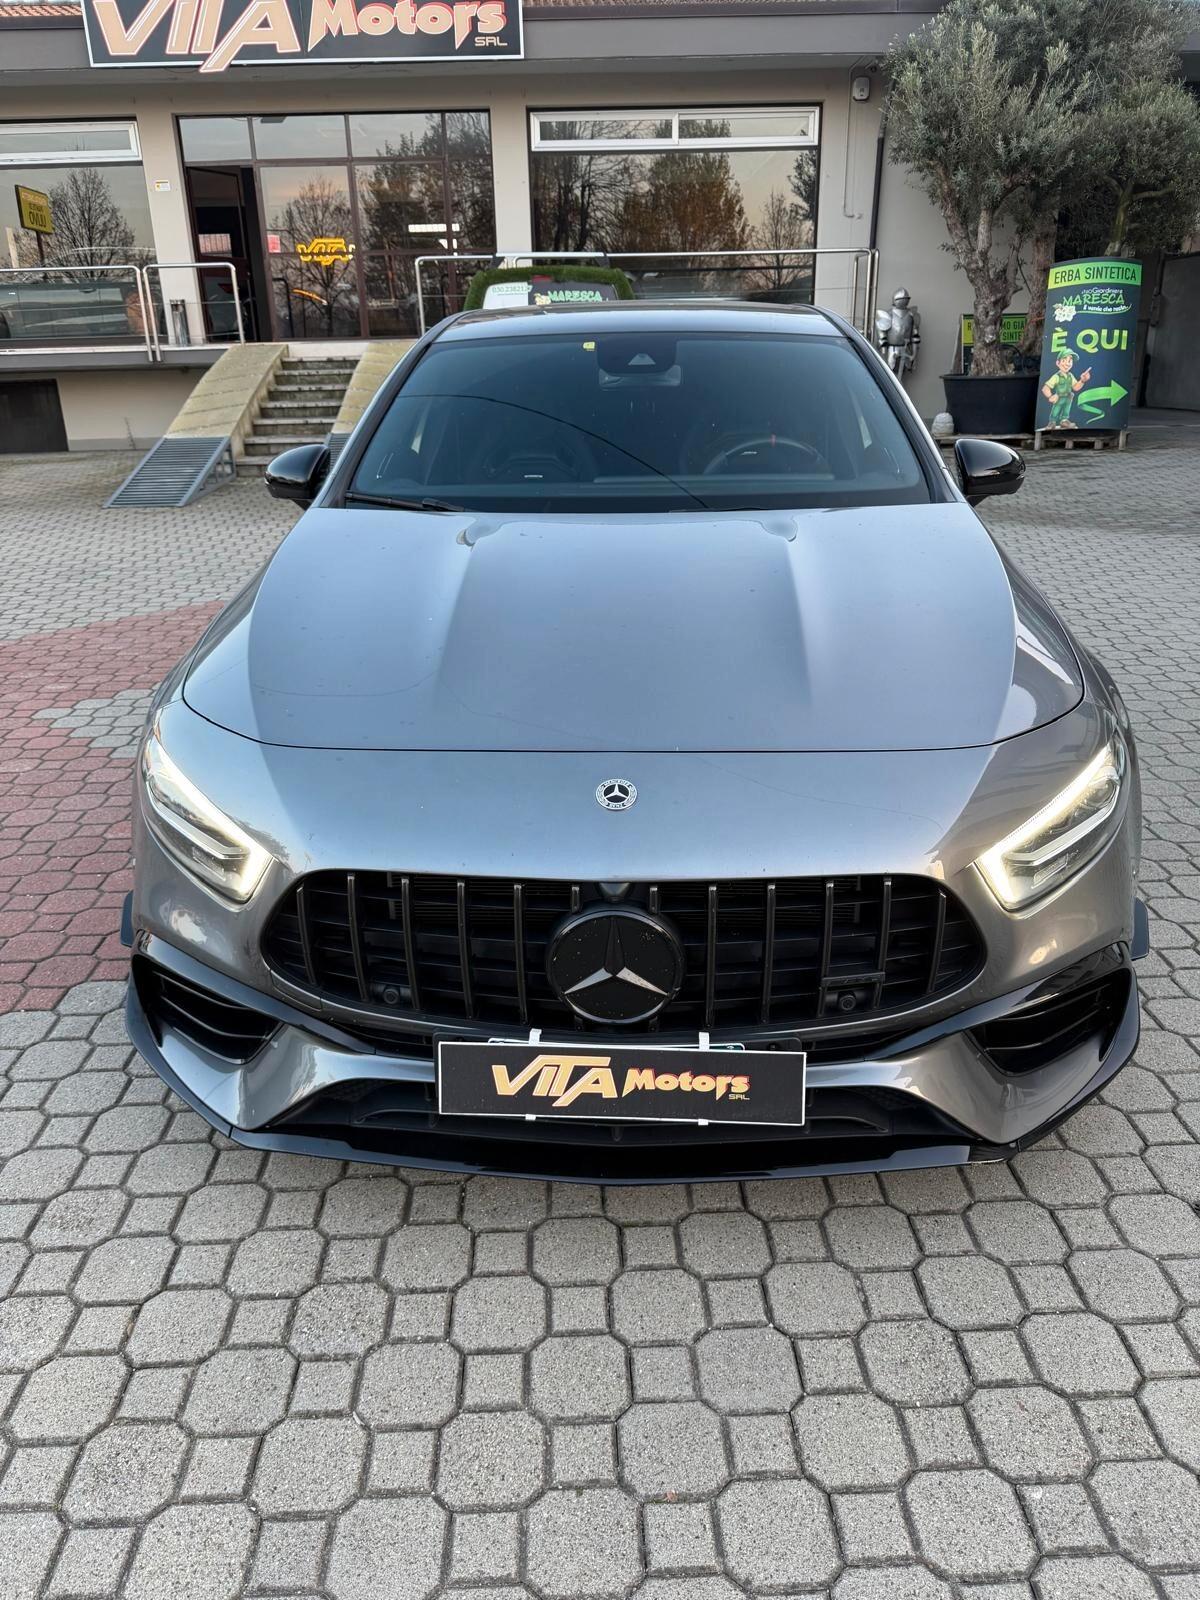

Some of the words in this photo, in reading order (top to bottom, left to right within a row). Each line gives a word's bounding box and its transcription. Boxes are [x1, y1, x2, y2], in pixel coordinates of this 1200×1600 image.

[308, 0, 507, 50] Motors
[474, 36, 508, 47] SRL
[1054, 268, 1081, 284] ERBA
[1085, 266, 1137, 281] SINTETICA
[548, 290, 602, 302] MARESCA
[1063, 293, 1125, 306] MARESCA
[1003, 331, 1022, 340] SINTE
[1051, 327, 1068, 352] È
[1076, 329, 1128, 353] QUI
[491, 1054, 618, 1107] VITA
[622, 1067, 751, 1101] Motors
[728, 1093, 750, 1101] SRL
